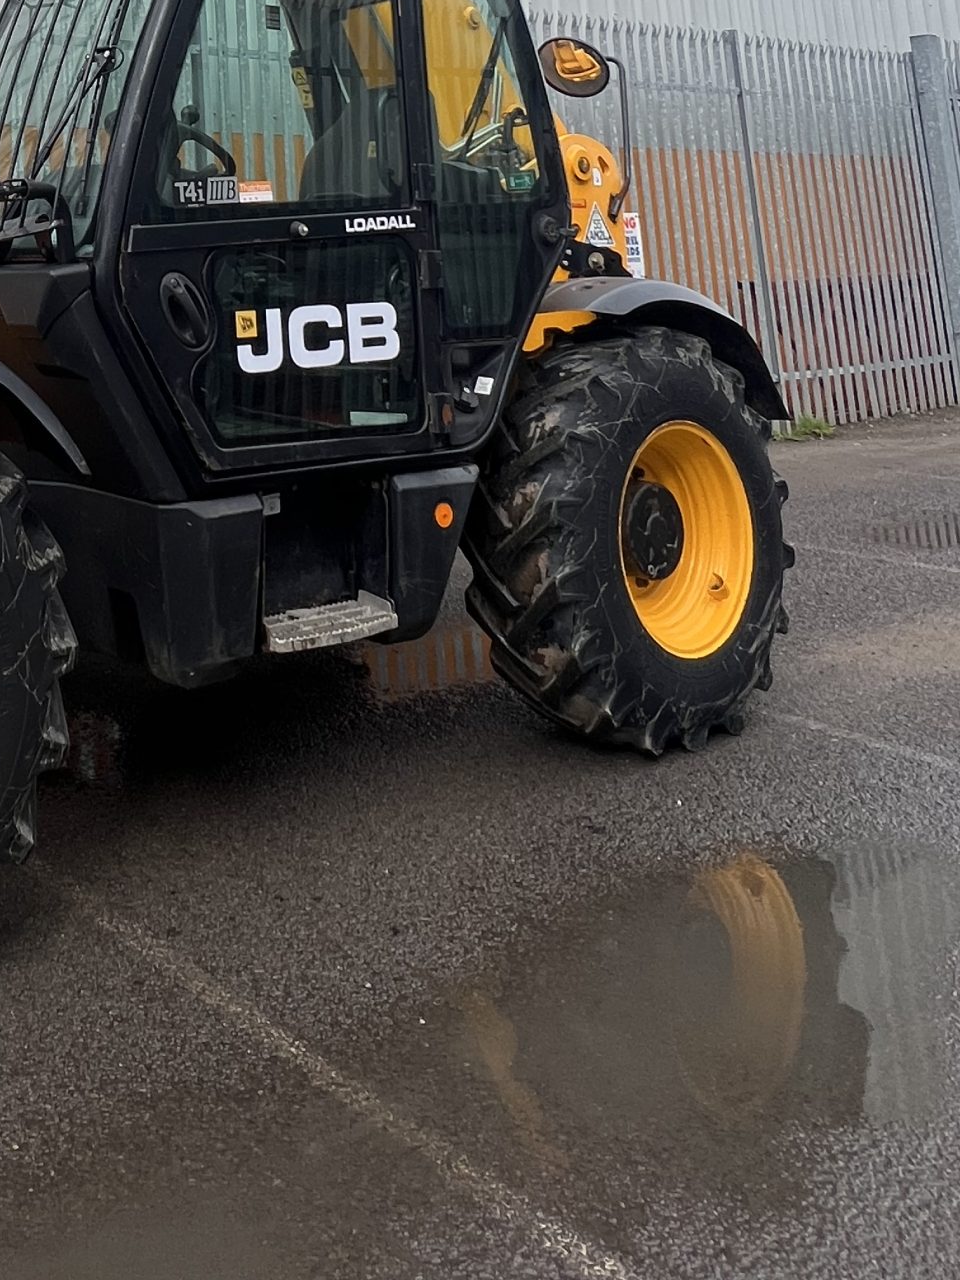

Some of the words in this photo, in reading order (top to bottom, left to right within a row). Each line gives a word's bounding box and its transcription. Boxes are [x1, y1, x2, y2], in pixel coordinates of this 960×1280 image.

[174, 181, 205, 203] T4i
[345, 215, 416, 232] LOADALL
[236, 302, 400, 374] JCB
